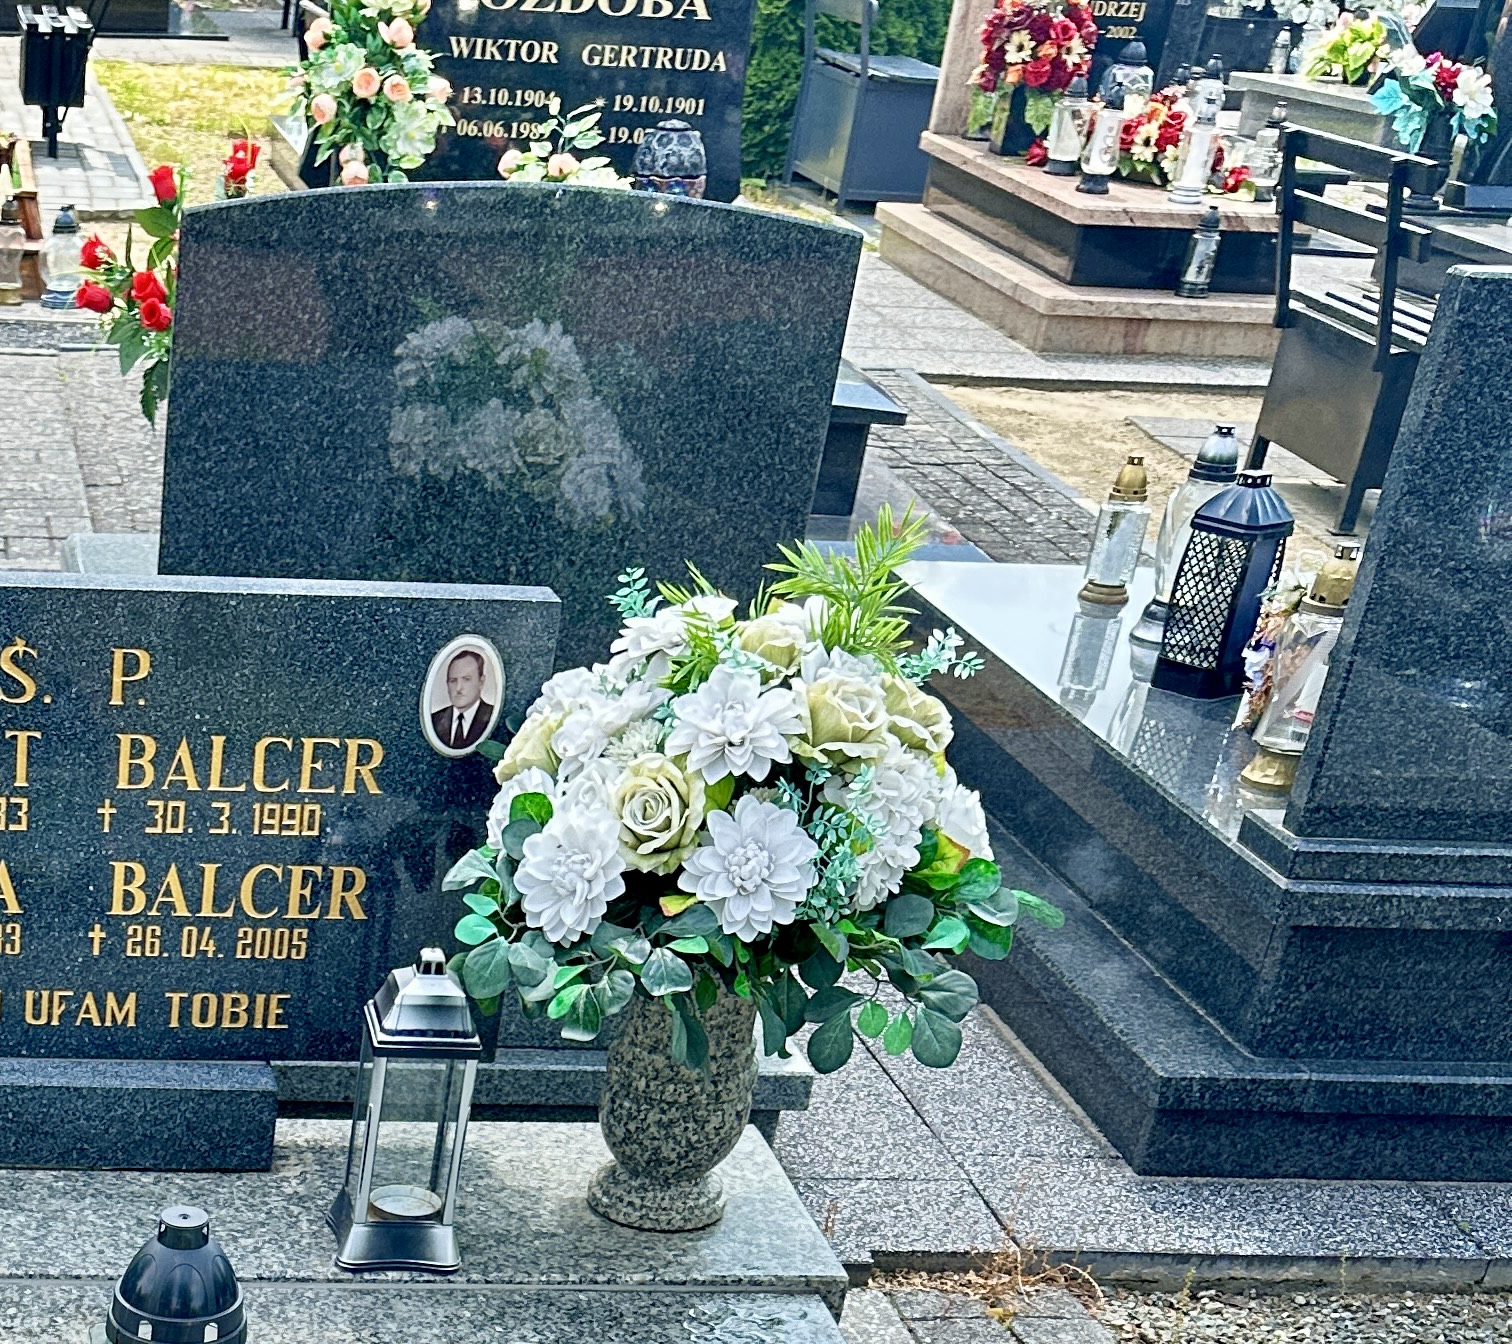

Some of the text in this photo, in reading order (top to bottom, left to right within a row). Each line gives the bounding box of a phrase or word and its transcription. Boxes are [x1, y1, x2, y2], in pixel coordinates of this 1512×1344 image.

[449, 36, 727, 72] WIKTOR GERTRUDA
[613, 94, 705, 116] 19.10.1901
[108, 647, 151, 706] P.
[115, 733, 385, 794] BALCER
[106, 860, 369, 920] BALCER
[24, 989, 138, 1027] UFAM
[164, 991, 292, 1030] TOBIE
